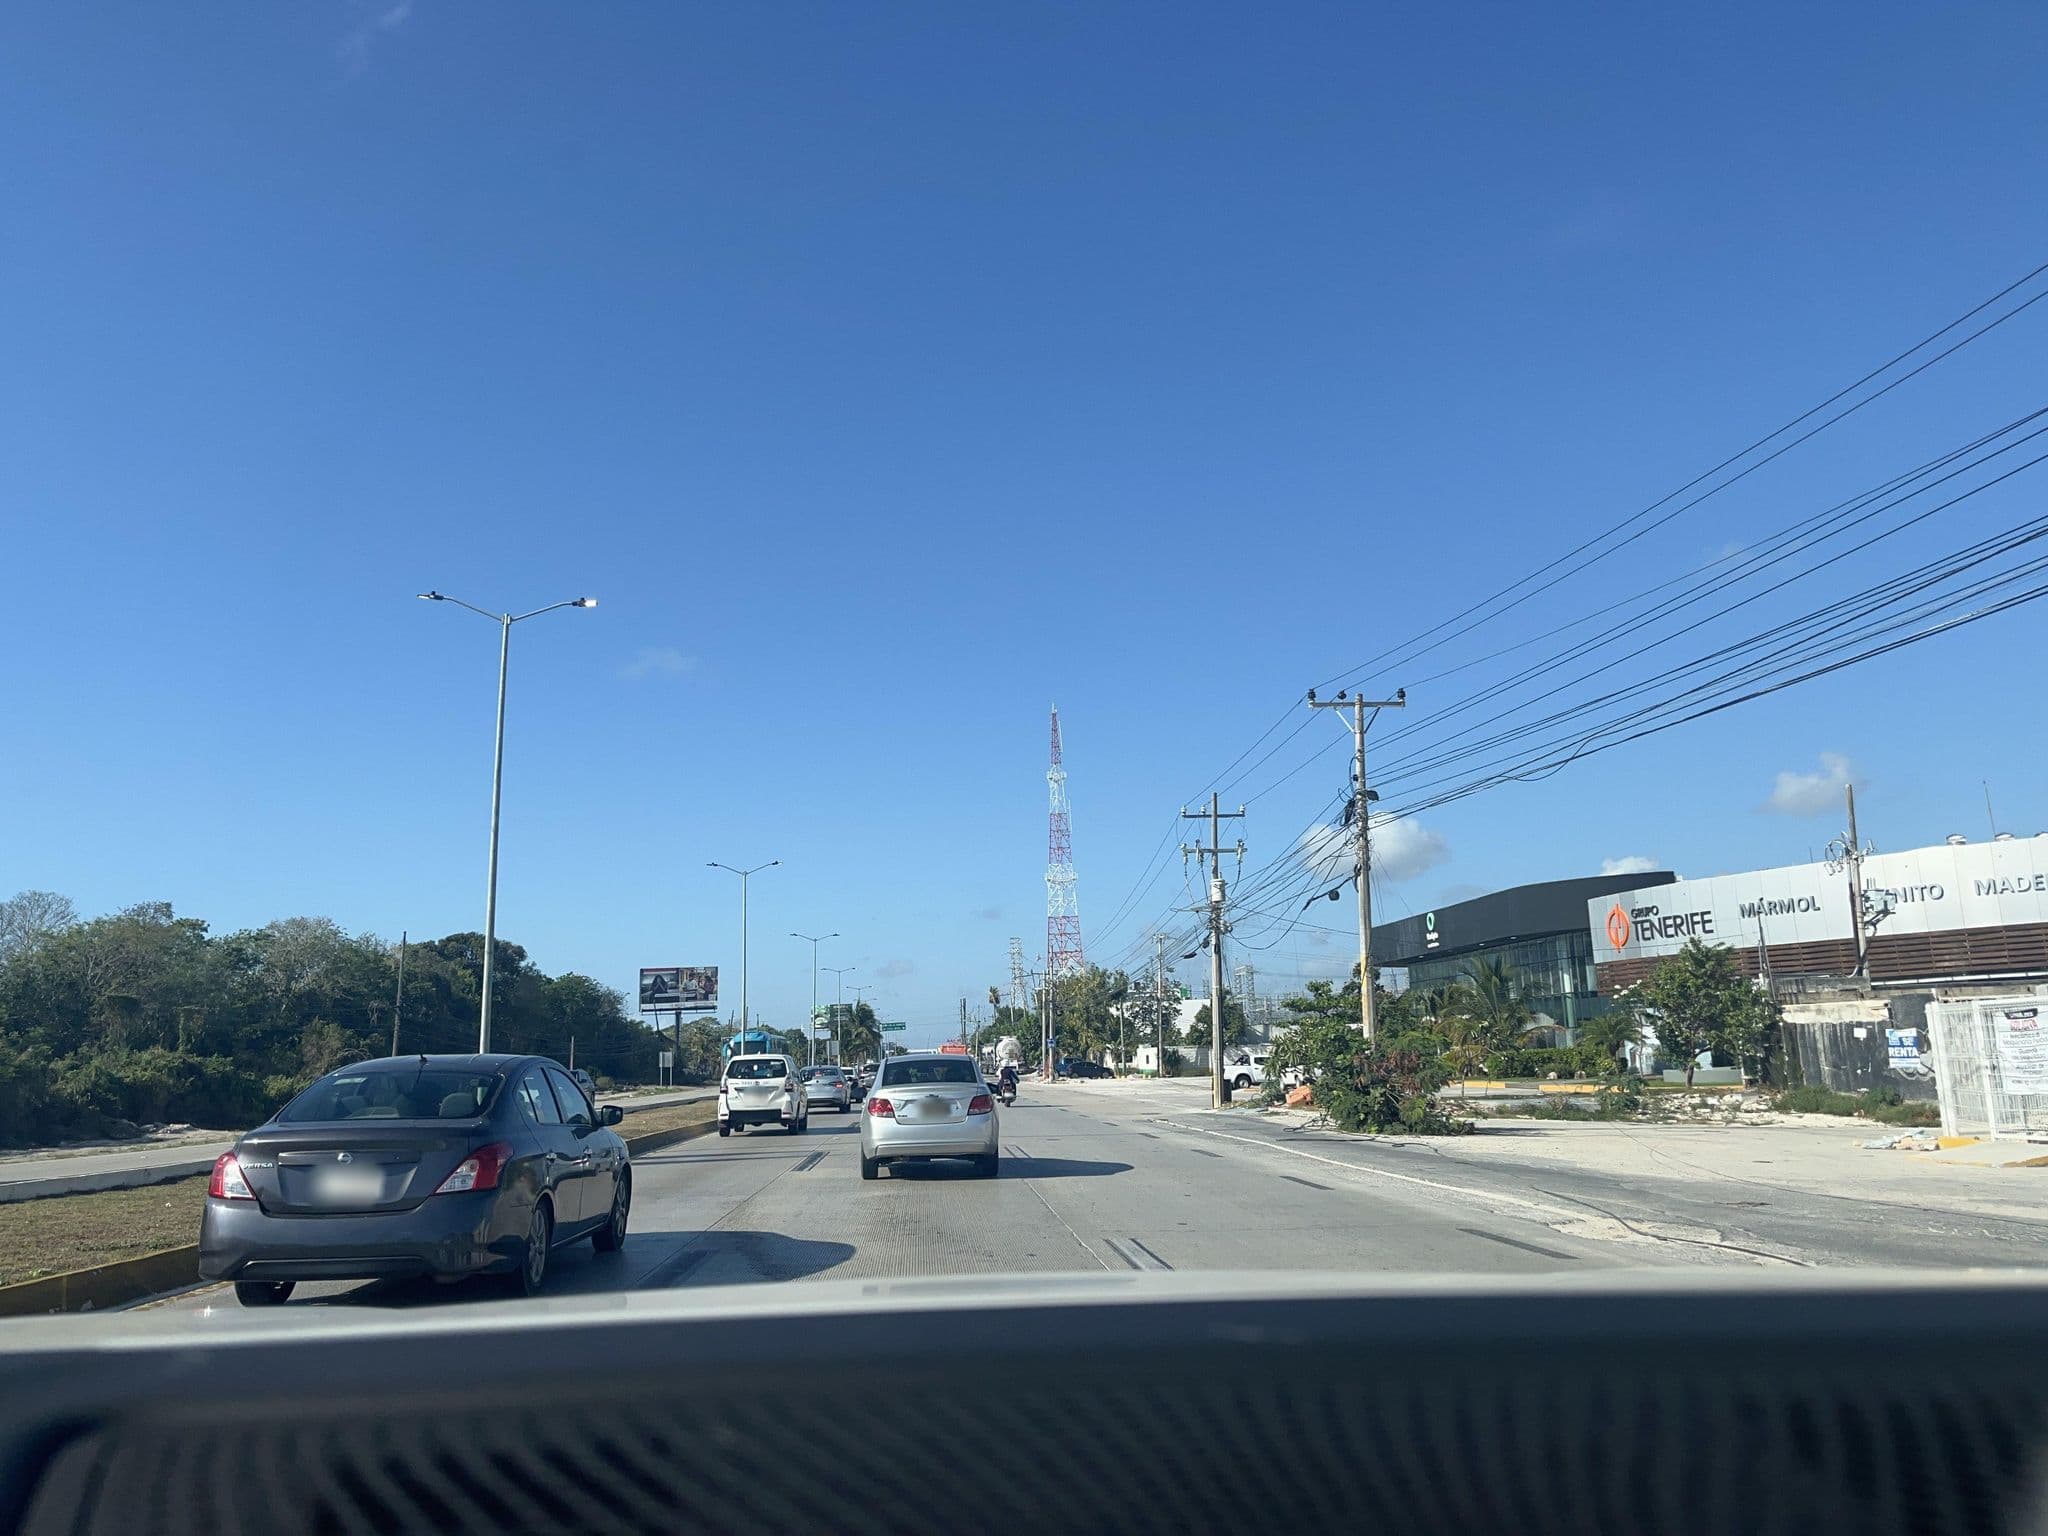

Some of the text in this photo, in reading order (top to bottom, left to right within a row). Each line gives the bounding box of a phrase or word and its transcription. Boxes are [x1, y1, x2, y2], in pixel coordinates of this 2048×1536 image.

[1739, 873, 2048, 919] MÁRMOL NITO MADE
[1631, 905, 1659, 919] GRUPO
[1632, 910, 1714, 942] TENERIFE
[1888, 1046, 1919, 1057] RENTA
